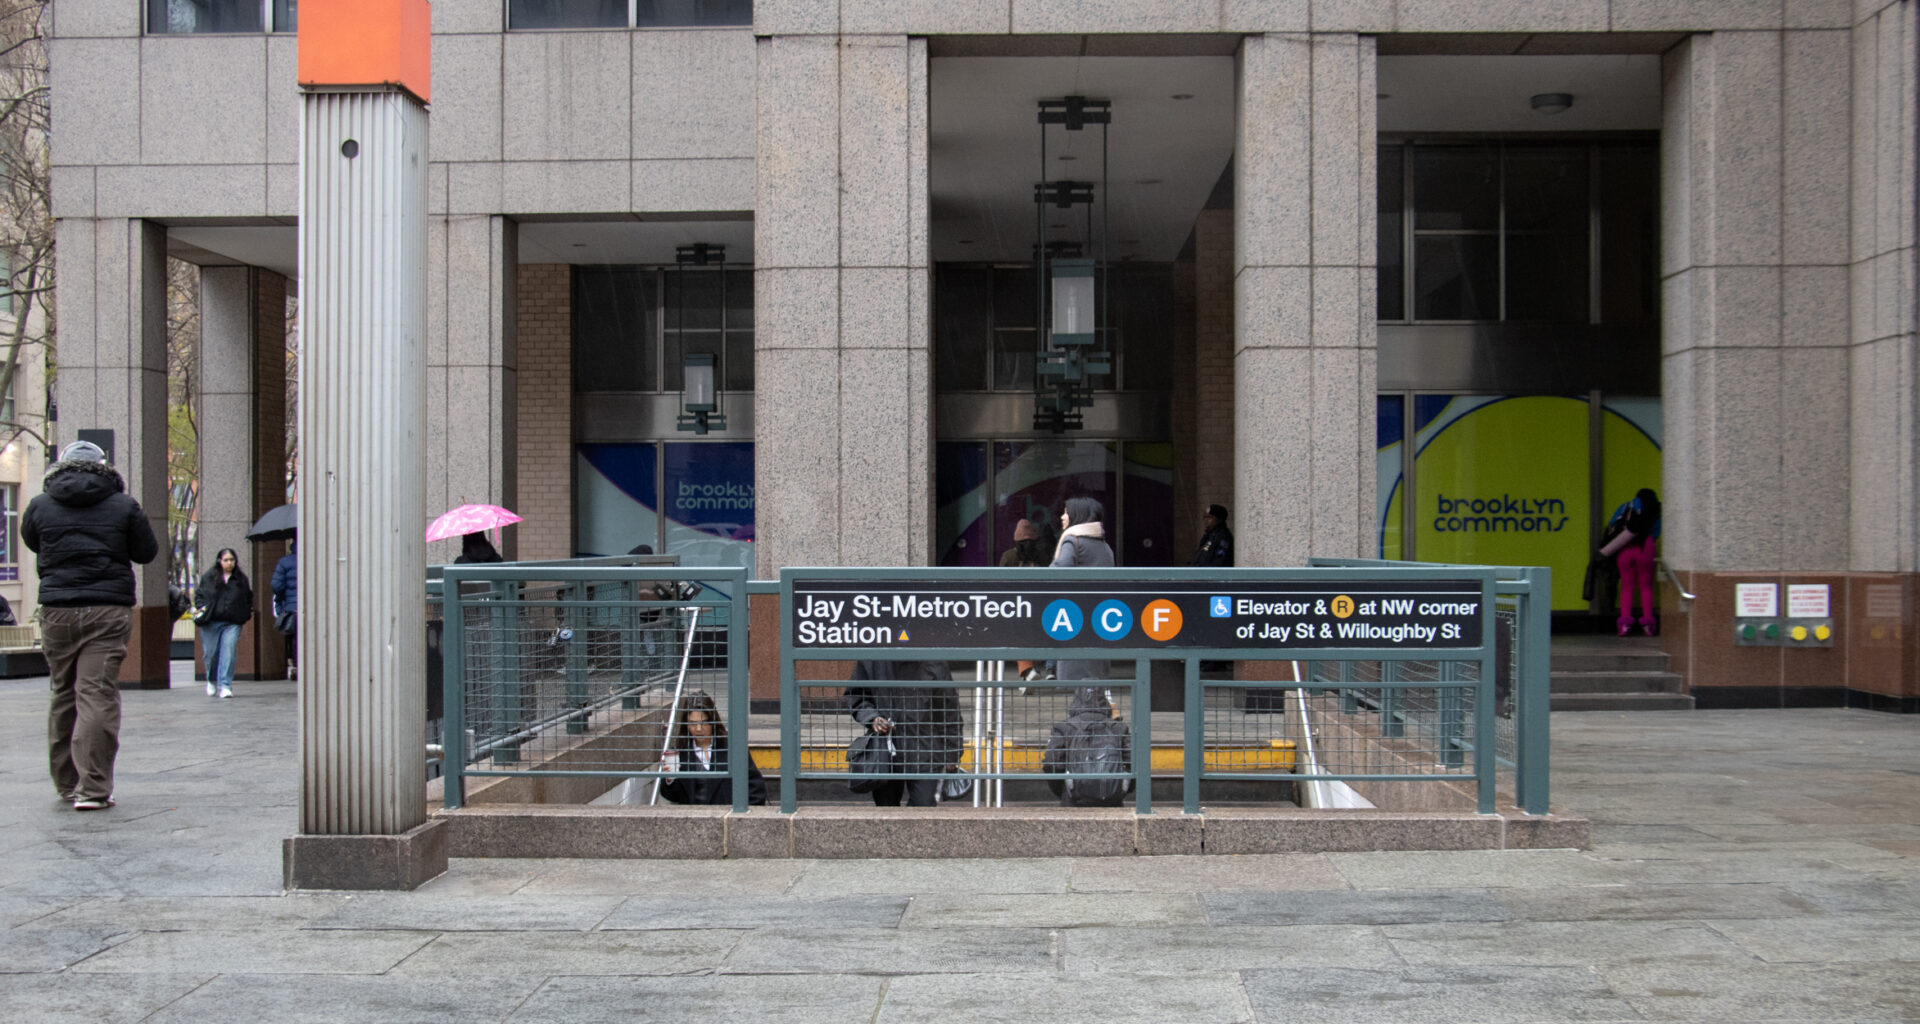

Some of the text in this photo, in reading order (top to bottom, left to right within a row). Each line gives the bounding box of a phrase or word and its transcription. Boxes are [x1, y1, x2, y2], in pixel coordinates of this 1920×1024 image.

[1434, 517, 1568, 532] commons
[798, 596, 1032, 621] Jay St-MetroTech
[1237, 599, 1478, 615] Elevator & R at NW corner
[1051, 608, 1170, 632] A C F
[798, 621, 892, 644] Station
[1236, 624, 1461, 643] of Jay St & Willoughby St
